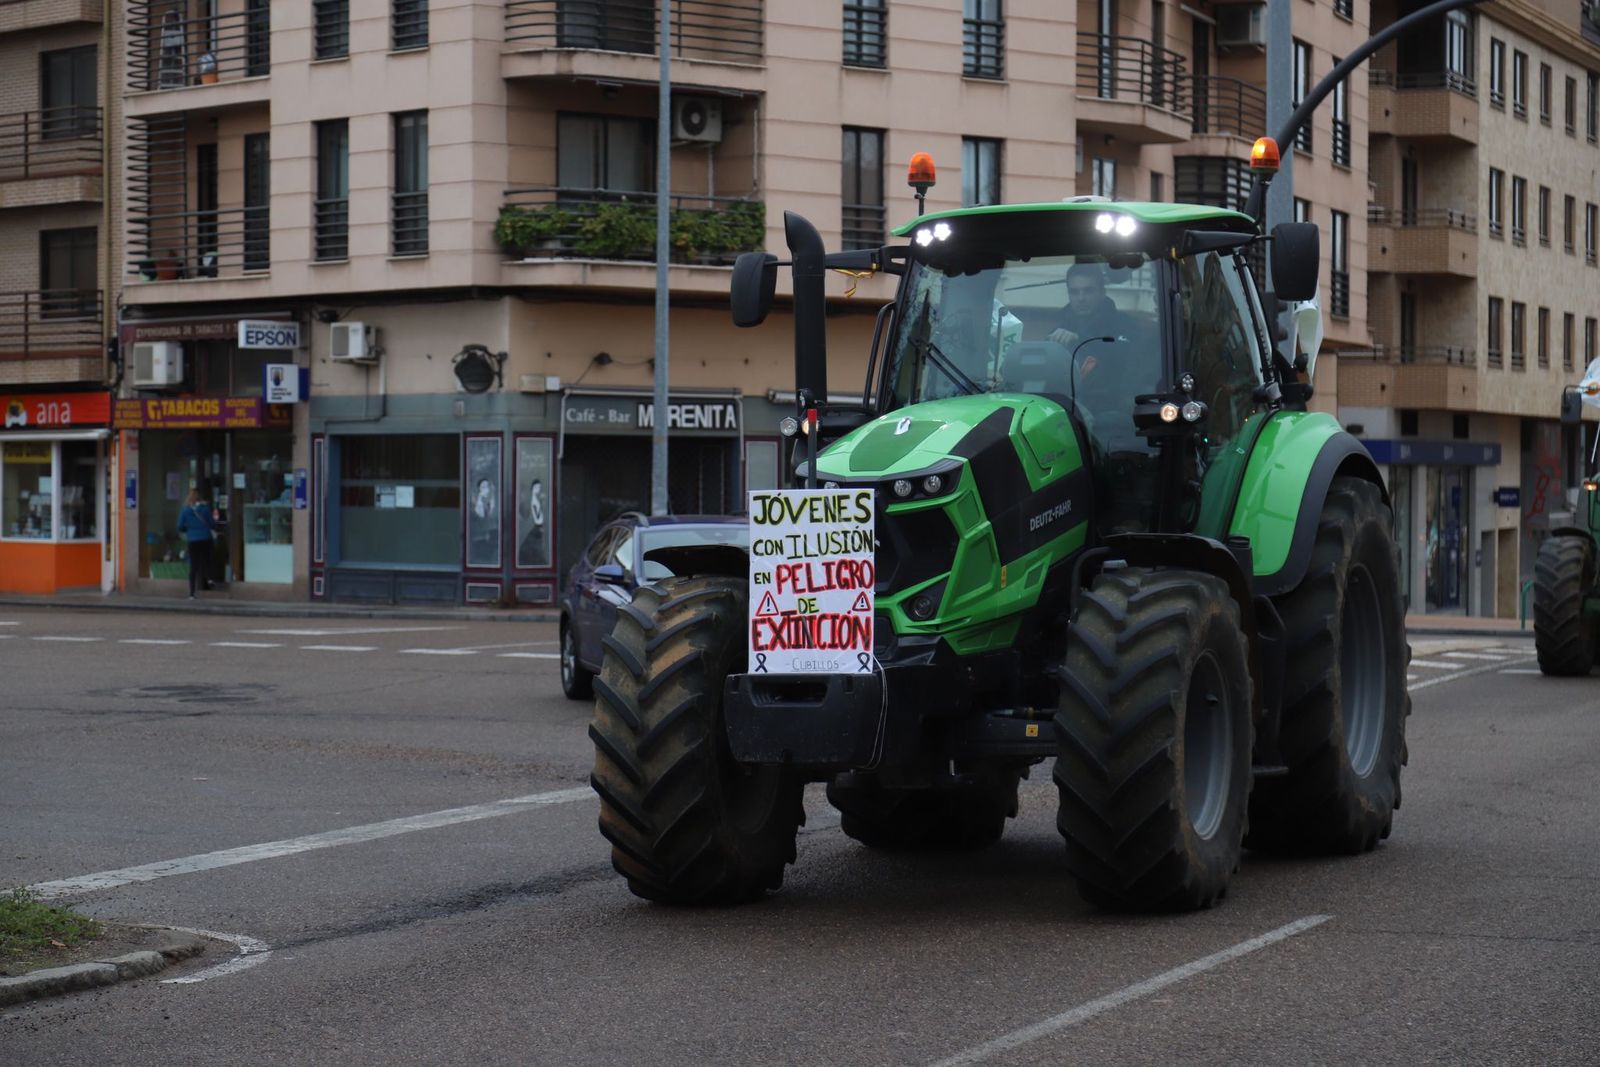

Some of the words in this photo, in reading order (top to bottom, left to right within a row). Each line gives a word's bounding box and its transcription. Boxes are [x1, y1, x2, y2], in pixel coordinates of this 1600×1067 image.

[246, 330, 297, 346] EPSON
[36, 402, 71, 424] ana
[161, 400, 220, 416] TABACOS
[566, 408, 595, 423] Café
[608, 409, 631, 423] Bar
[637, 404, 737, 428] MRENITA
[752, 492, 872, 526] JÓVENES
[1030, 499, 1072, 532] DEUTZ-FAHR
[752, 539, 785, 557] CON
[785, 526, 874, 560] ILUSIÓN
[754, 572, 771, 585] EN
[775, 558, 875, 595] PELIGRO
[797, 597, 820, 614] DE
[751, 610, 872, 652] EXTINCIÓN
